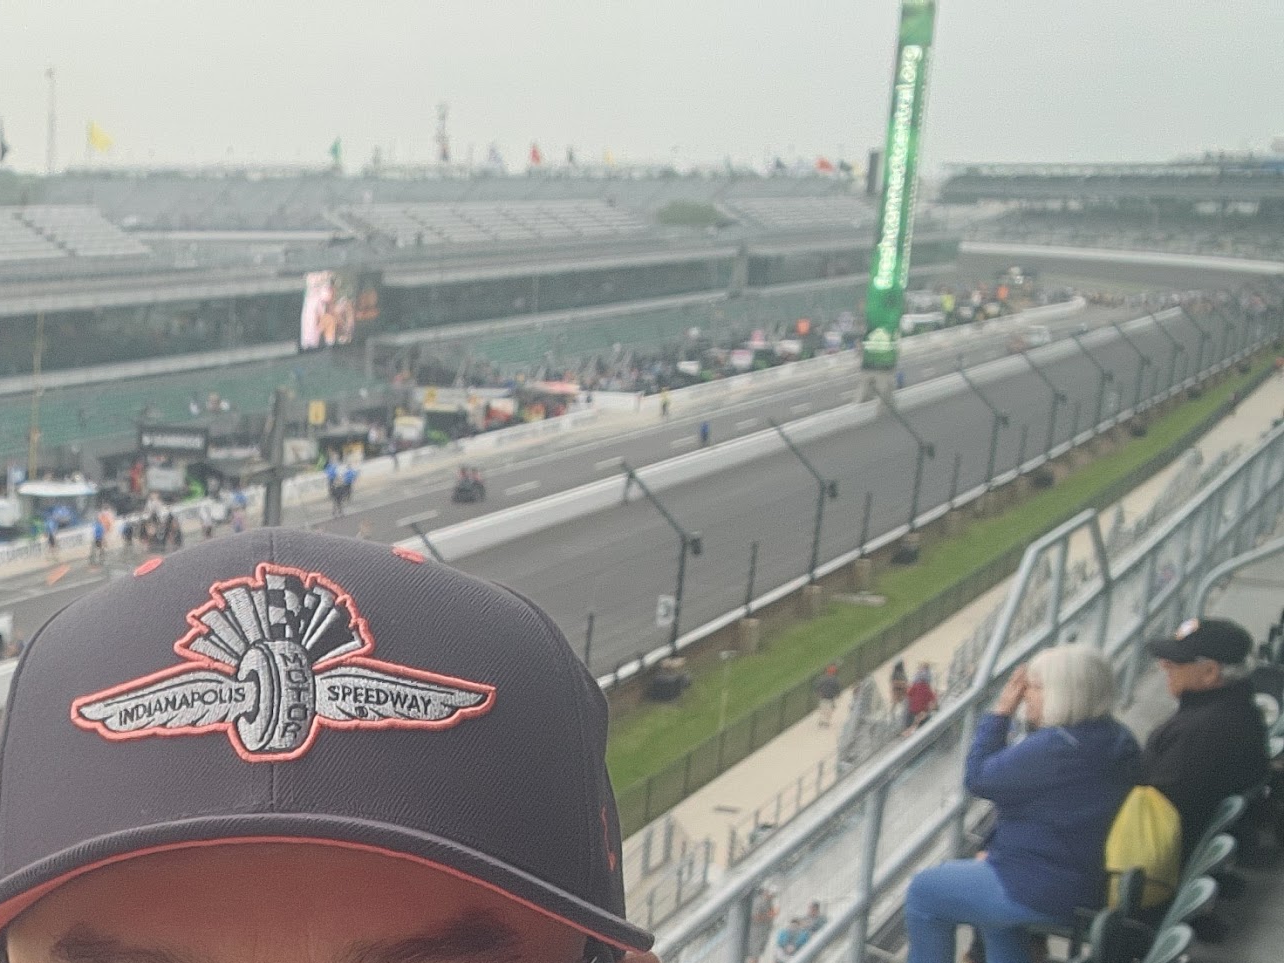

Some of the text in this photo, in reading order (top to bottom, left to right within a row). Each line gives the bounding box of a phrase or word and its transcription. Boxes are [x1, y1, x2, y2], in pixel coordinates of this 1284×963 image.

[118, 687, 246, 726] INDIANAPOLIS
[279, 652, 310, 739] MOTOR
[327, 685, 433, 715] SPEEDWAY
